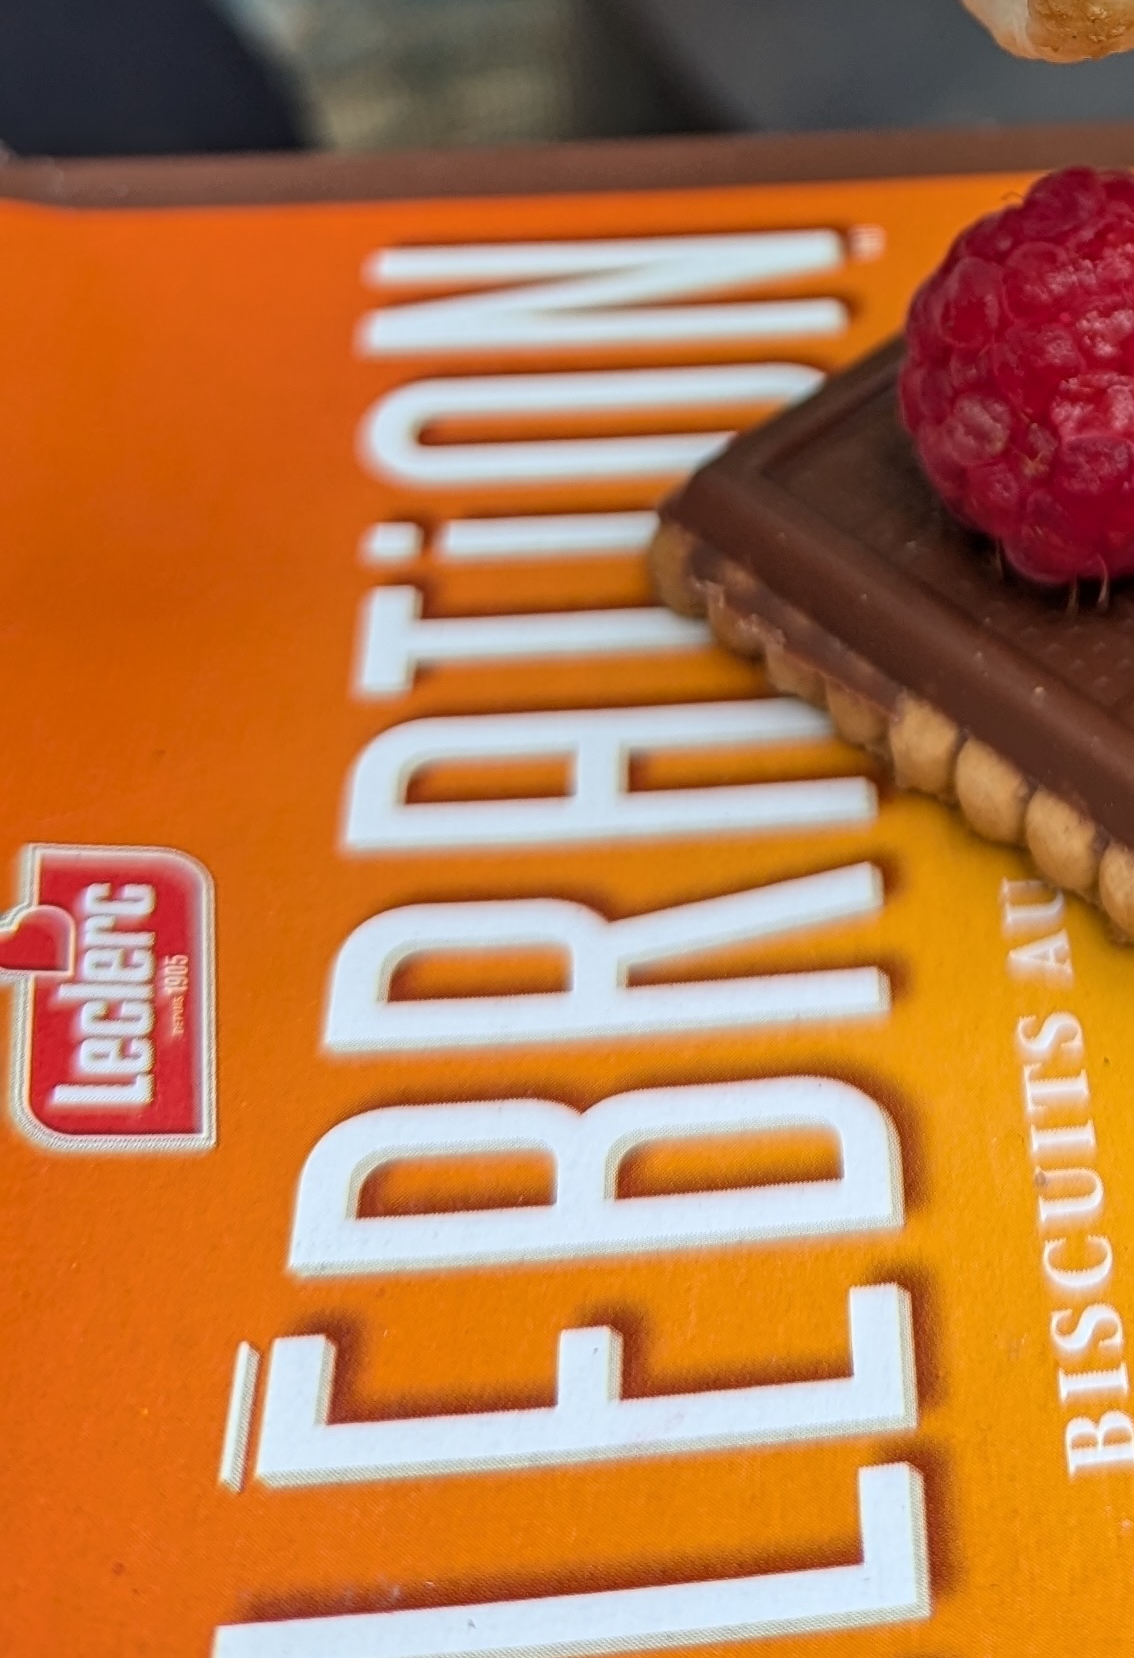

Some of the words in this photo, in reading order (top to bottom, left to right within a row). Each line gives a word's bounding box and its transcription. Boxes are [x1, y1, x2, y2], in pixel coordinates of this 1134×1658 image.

[164, 953, 189, 994] 1905
[999, 875, 1075, 988] AU
[52, 882, 156, 1104] Leclerc
